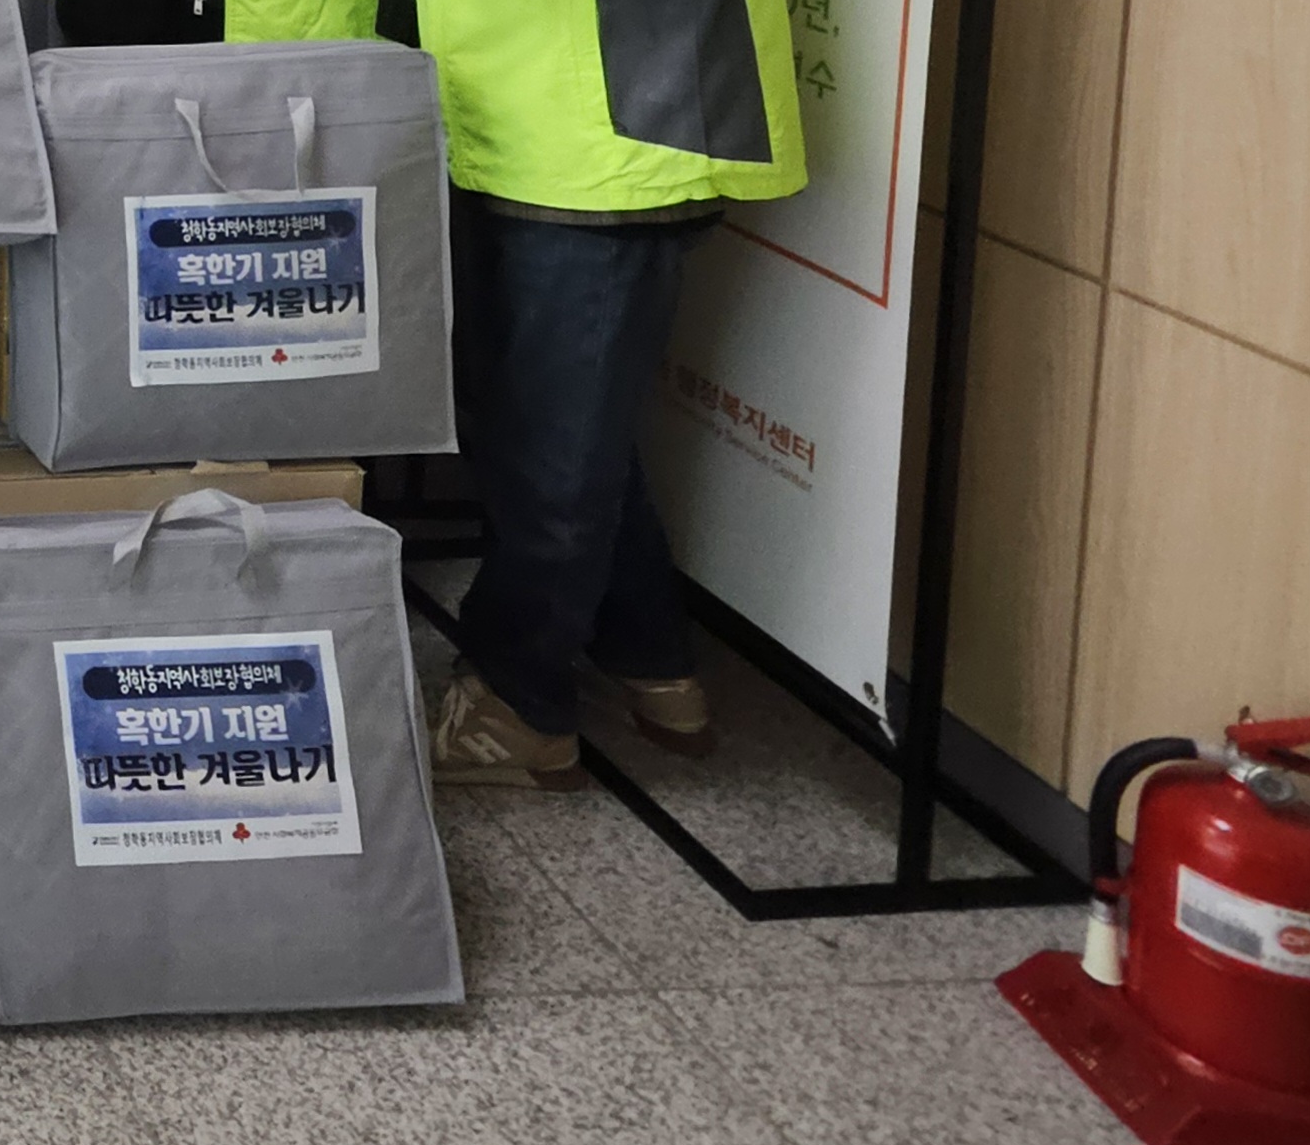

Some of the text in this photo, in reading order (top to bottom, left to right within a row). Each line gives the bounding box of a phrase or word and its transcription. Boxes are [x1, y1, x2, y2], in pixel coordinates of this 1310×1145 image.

[181, 214, 326, 243] 청학동지역사회보장협의체
[177, 248, 328, 286] 혹한기 지원
[144, 281, 366, 324] 따뜻한 겨울나기
[117, 663, 282, 696] 청학동지역사회보장협의체
[115, 703, 289, 746] 혹한기 지원
[80, 743, 338, 792] 따뜻한 겨울나기
